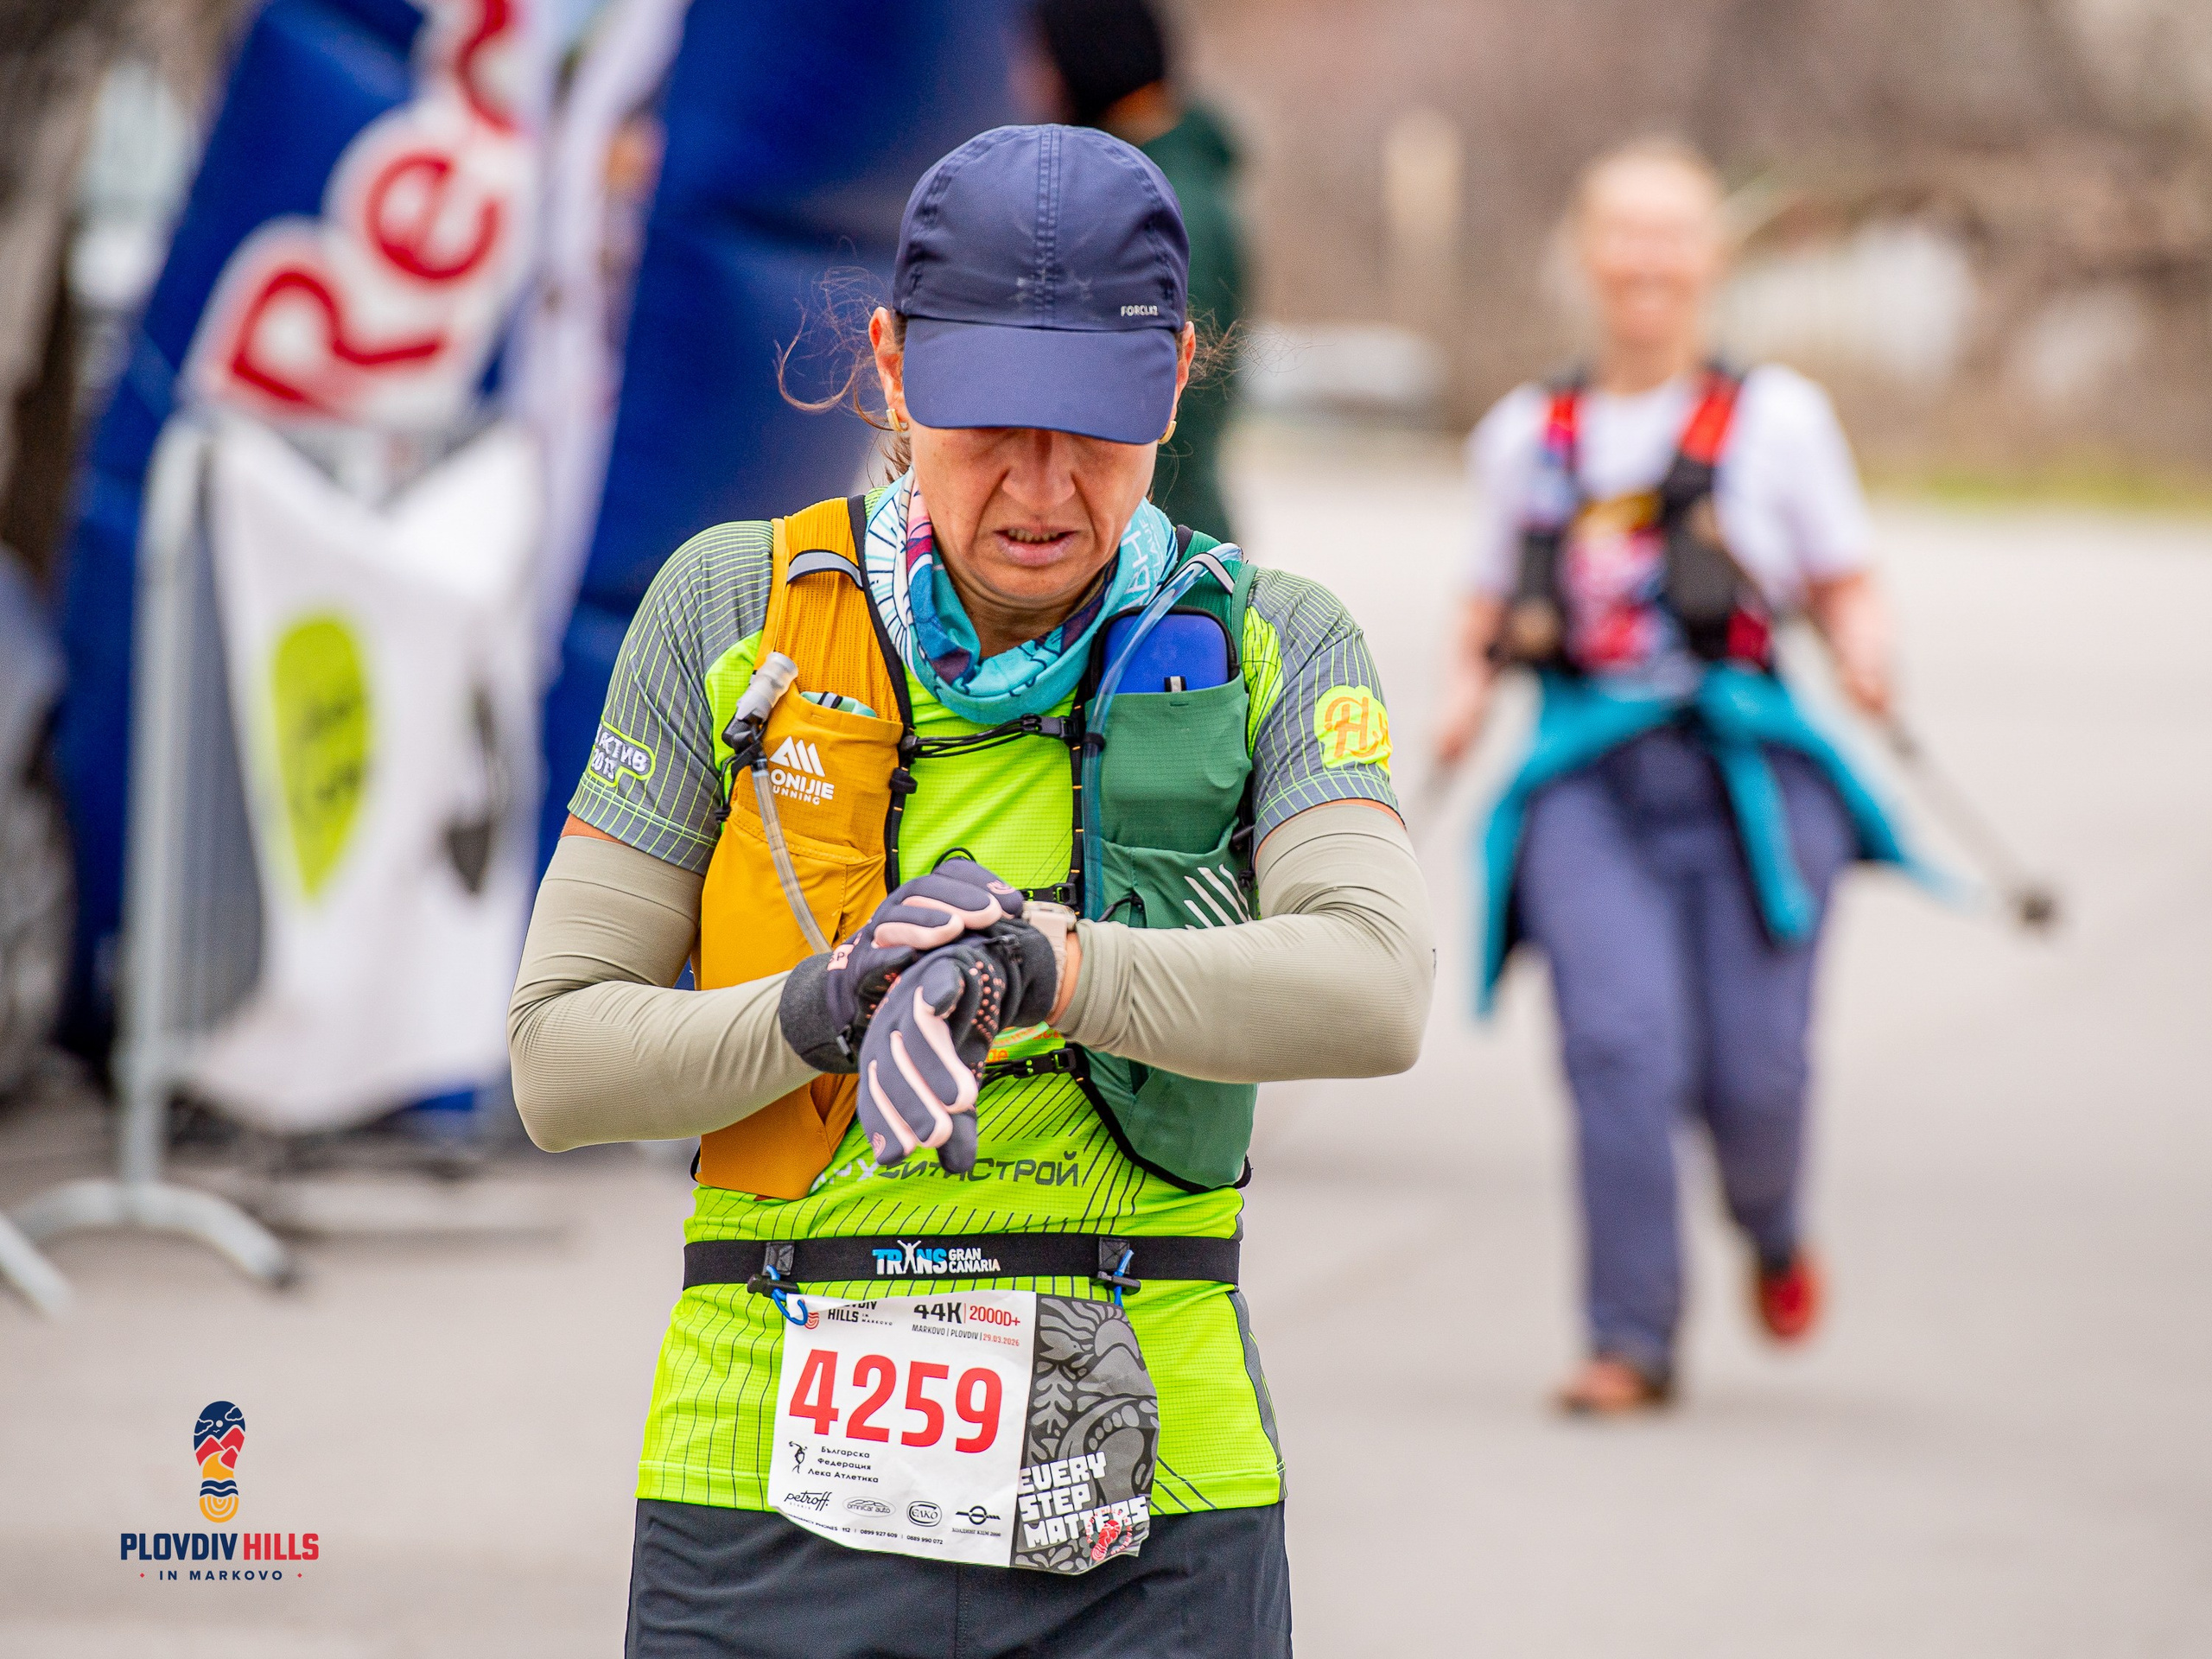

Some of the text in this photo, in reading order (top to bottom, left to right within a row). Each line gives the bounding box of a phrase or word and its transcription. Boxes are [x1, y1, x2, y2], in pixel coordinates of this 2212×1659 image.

[771, 768, 835, 800] ONIJIE
[772, 785, 821, 805] UNNING
[949, 1248, 982, 1261] GRAN
[948, 1258, 1001, 1274] CANARIA
[827, 1308, 860, 1323] HILLS
[913, 1301, 963, 1325] 44K
[912, 1323, 1020, 1347] MARKOVO PLOVDIV 29.03.2026
[789, 1349, 1003, 1454] 4259
[821, 1446, 870, 1459] Българска
[817, 1458, 872, 1471] Федерация
[1017, 1451, 1107, 1495] EVERY
[807, 1468, 880, 1484] Лека Атлетика
[1018, 1483, 1091, 1522] STEP
[1023, 1496, 1150, 1548] MATTERS
